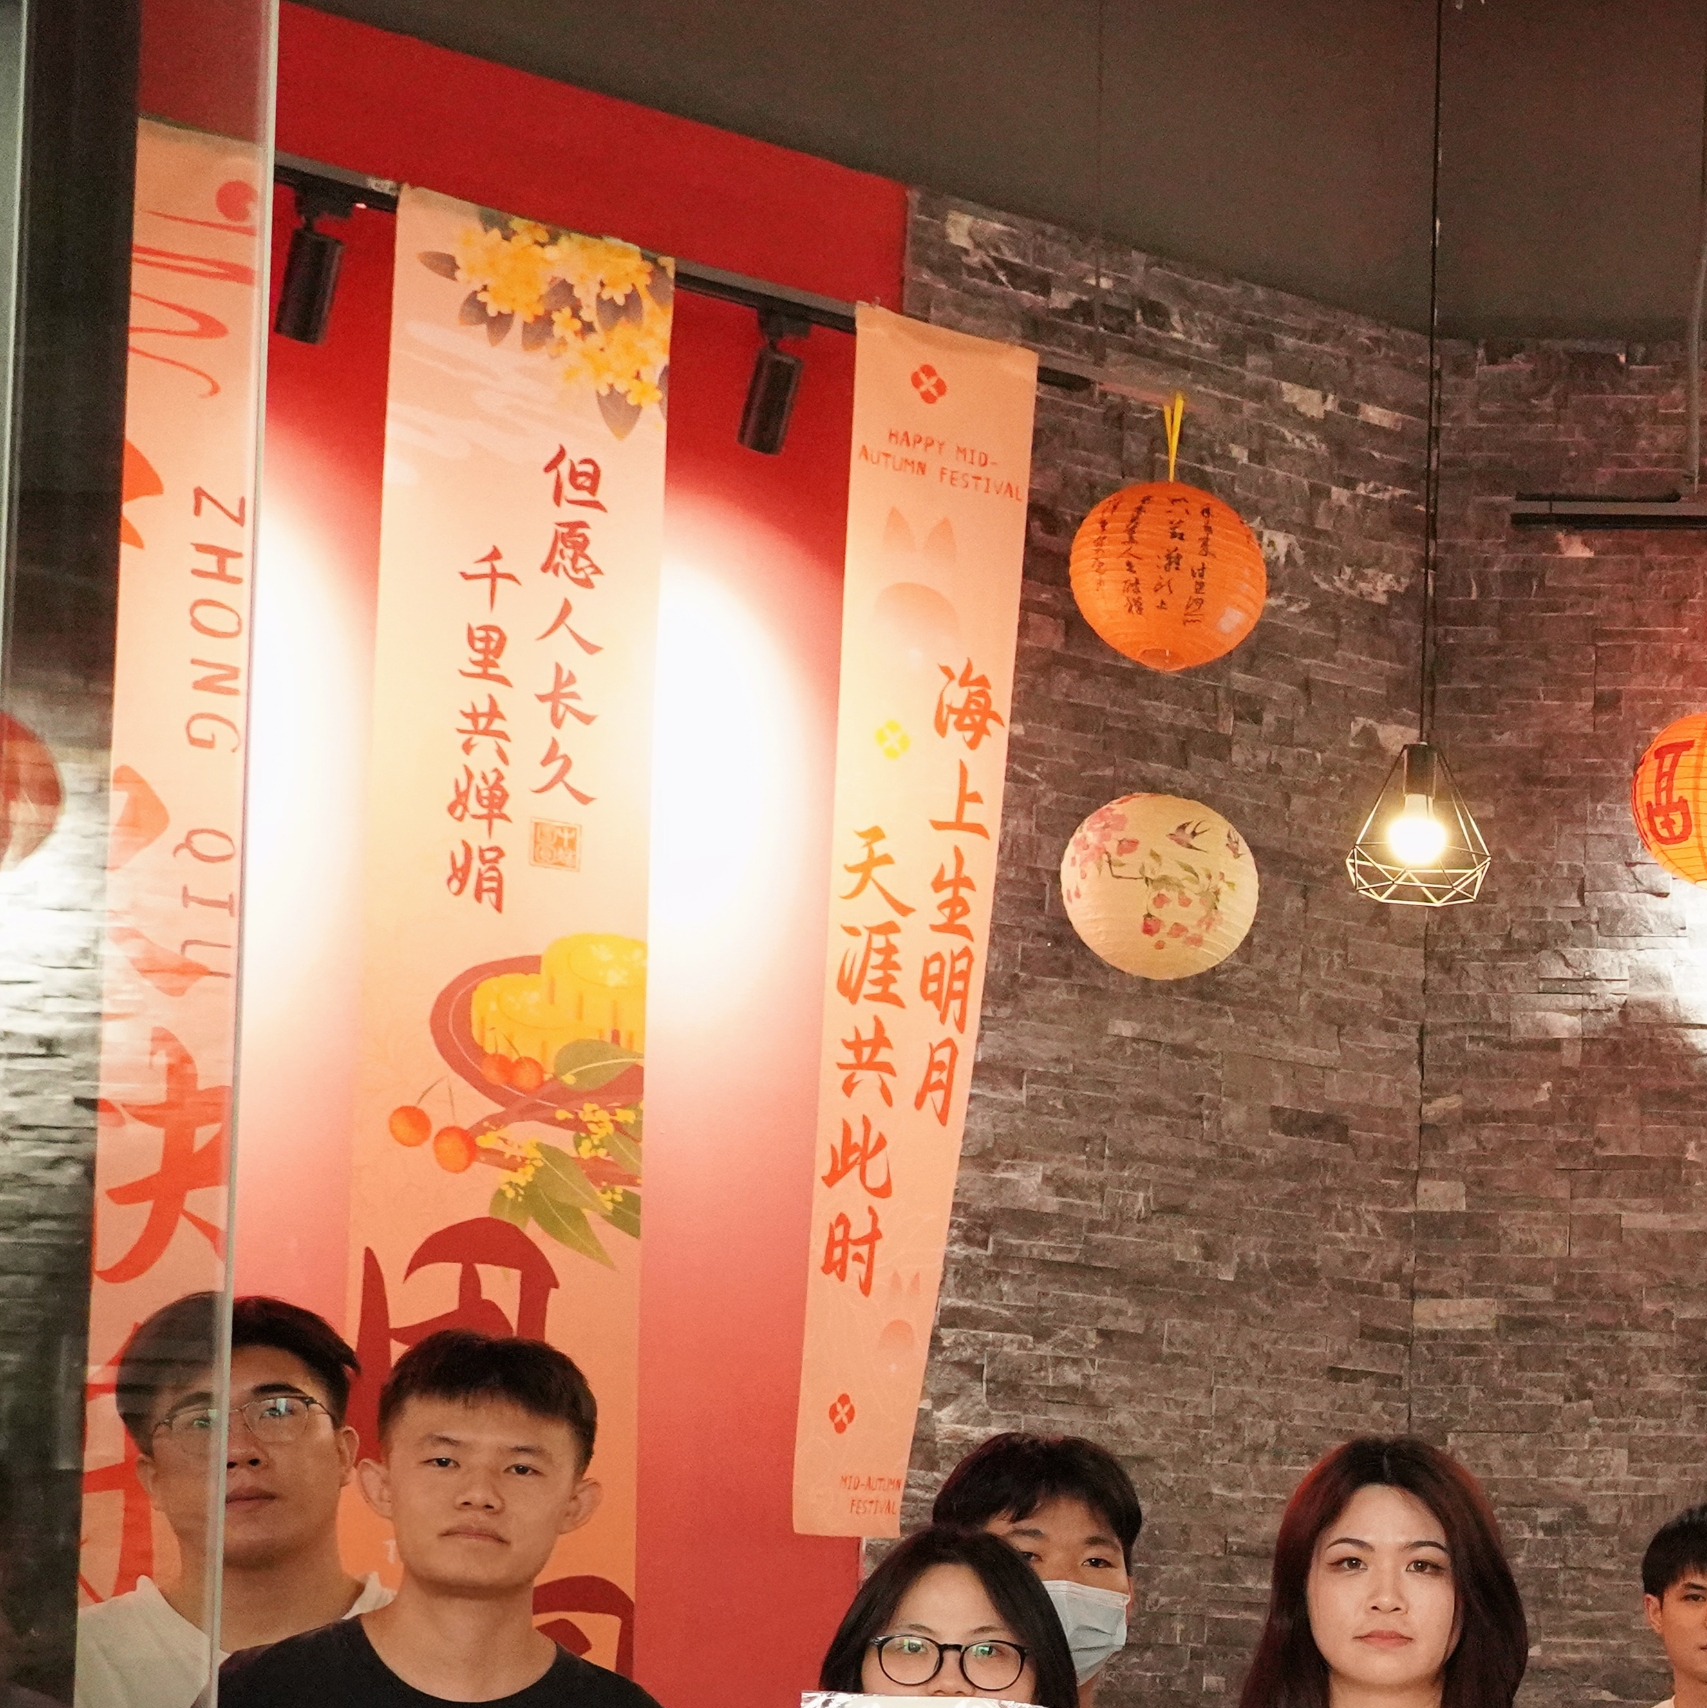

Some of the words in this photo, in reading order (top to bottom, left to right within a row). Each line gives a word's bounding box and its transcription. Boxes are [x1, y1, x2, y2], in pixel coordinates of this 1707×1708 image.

[185, 486, 246, 753] ZHONG
[858, 444, 927, 476] AUTUMN
[939, 467, 1022, 502] FESTIVAL
[888, 428, 945, 455] HAPPY
[444, 546, 522, 915] 千里共婵娟
[528, 443, 607, 808] 但愿人长久
[820, 825, 916, 1299] 天涯共此时
[913, 657, 1004, 1127] 海上生明月
